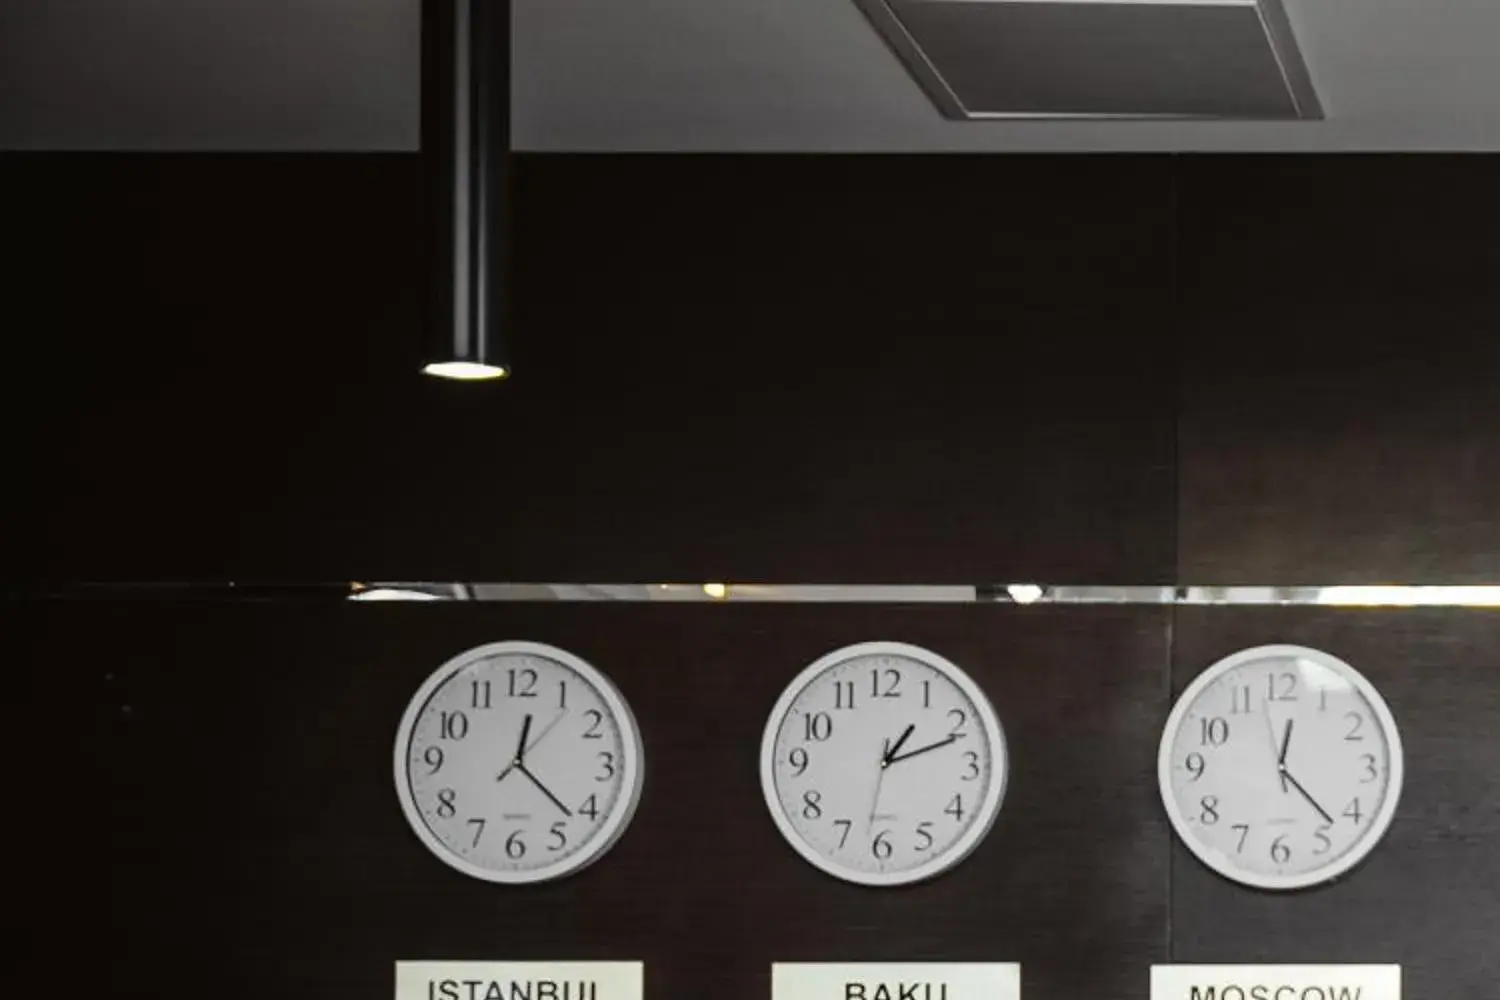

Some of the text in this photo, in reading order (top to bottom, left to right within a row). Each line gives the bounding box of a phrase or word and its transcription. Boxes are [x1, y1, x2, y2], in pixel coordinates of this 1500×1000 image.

[471, 680, 492, 709] 11
[506, 669, 538, 697] 12
[558, 680, 566, 708] 1
[834, 681, 856, 709] 11
[870, 669, 901, 697] 12
[921, 680, 932, 708] 1
[1265, 673, 1297, 701] 12
[1231, 686, 1252, 714] 11
[1318, 687, 1326, 711] 1
[440, 711, 468, 740] 10
[582, 709, 603, 738] 2
[805, 712, 832, 741] 10
[947, 709, 966, 739] 2
[1200, 717, 1228, 746] 10
[1344, 712, 1362, 740] 2
[424, 747, 444, 775] 9
[595, 752, 614, 782] 3
[789, 748, 808, 777] 9
[961, 752, 979, 781] 3
[1186, 752, 1205, 781] 9
[1359, 754, 1377, 782] 3
[437, 788, 456, 818] 8
[578, 794, 599, 821] 4
[803, 790, 822, 819] 8
[944, 794, 964, 822] 4
[1201, 795, 1220, 824] 8
[1342, 797, 1362, 824] 4
[468, 819, 485, 848] 7
[505, 830, 526, 859] 6
[547, 822, 566, 851] 5
[834, 819, 851, 848] 7
[872, 830, 892, 860] 6
[914, 822, 933, 851] 5
[1231, 825, 1248, 853] 7
[1312, 825, 1332, 854] 5
[1271, 834, 1291, 863] 6
